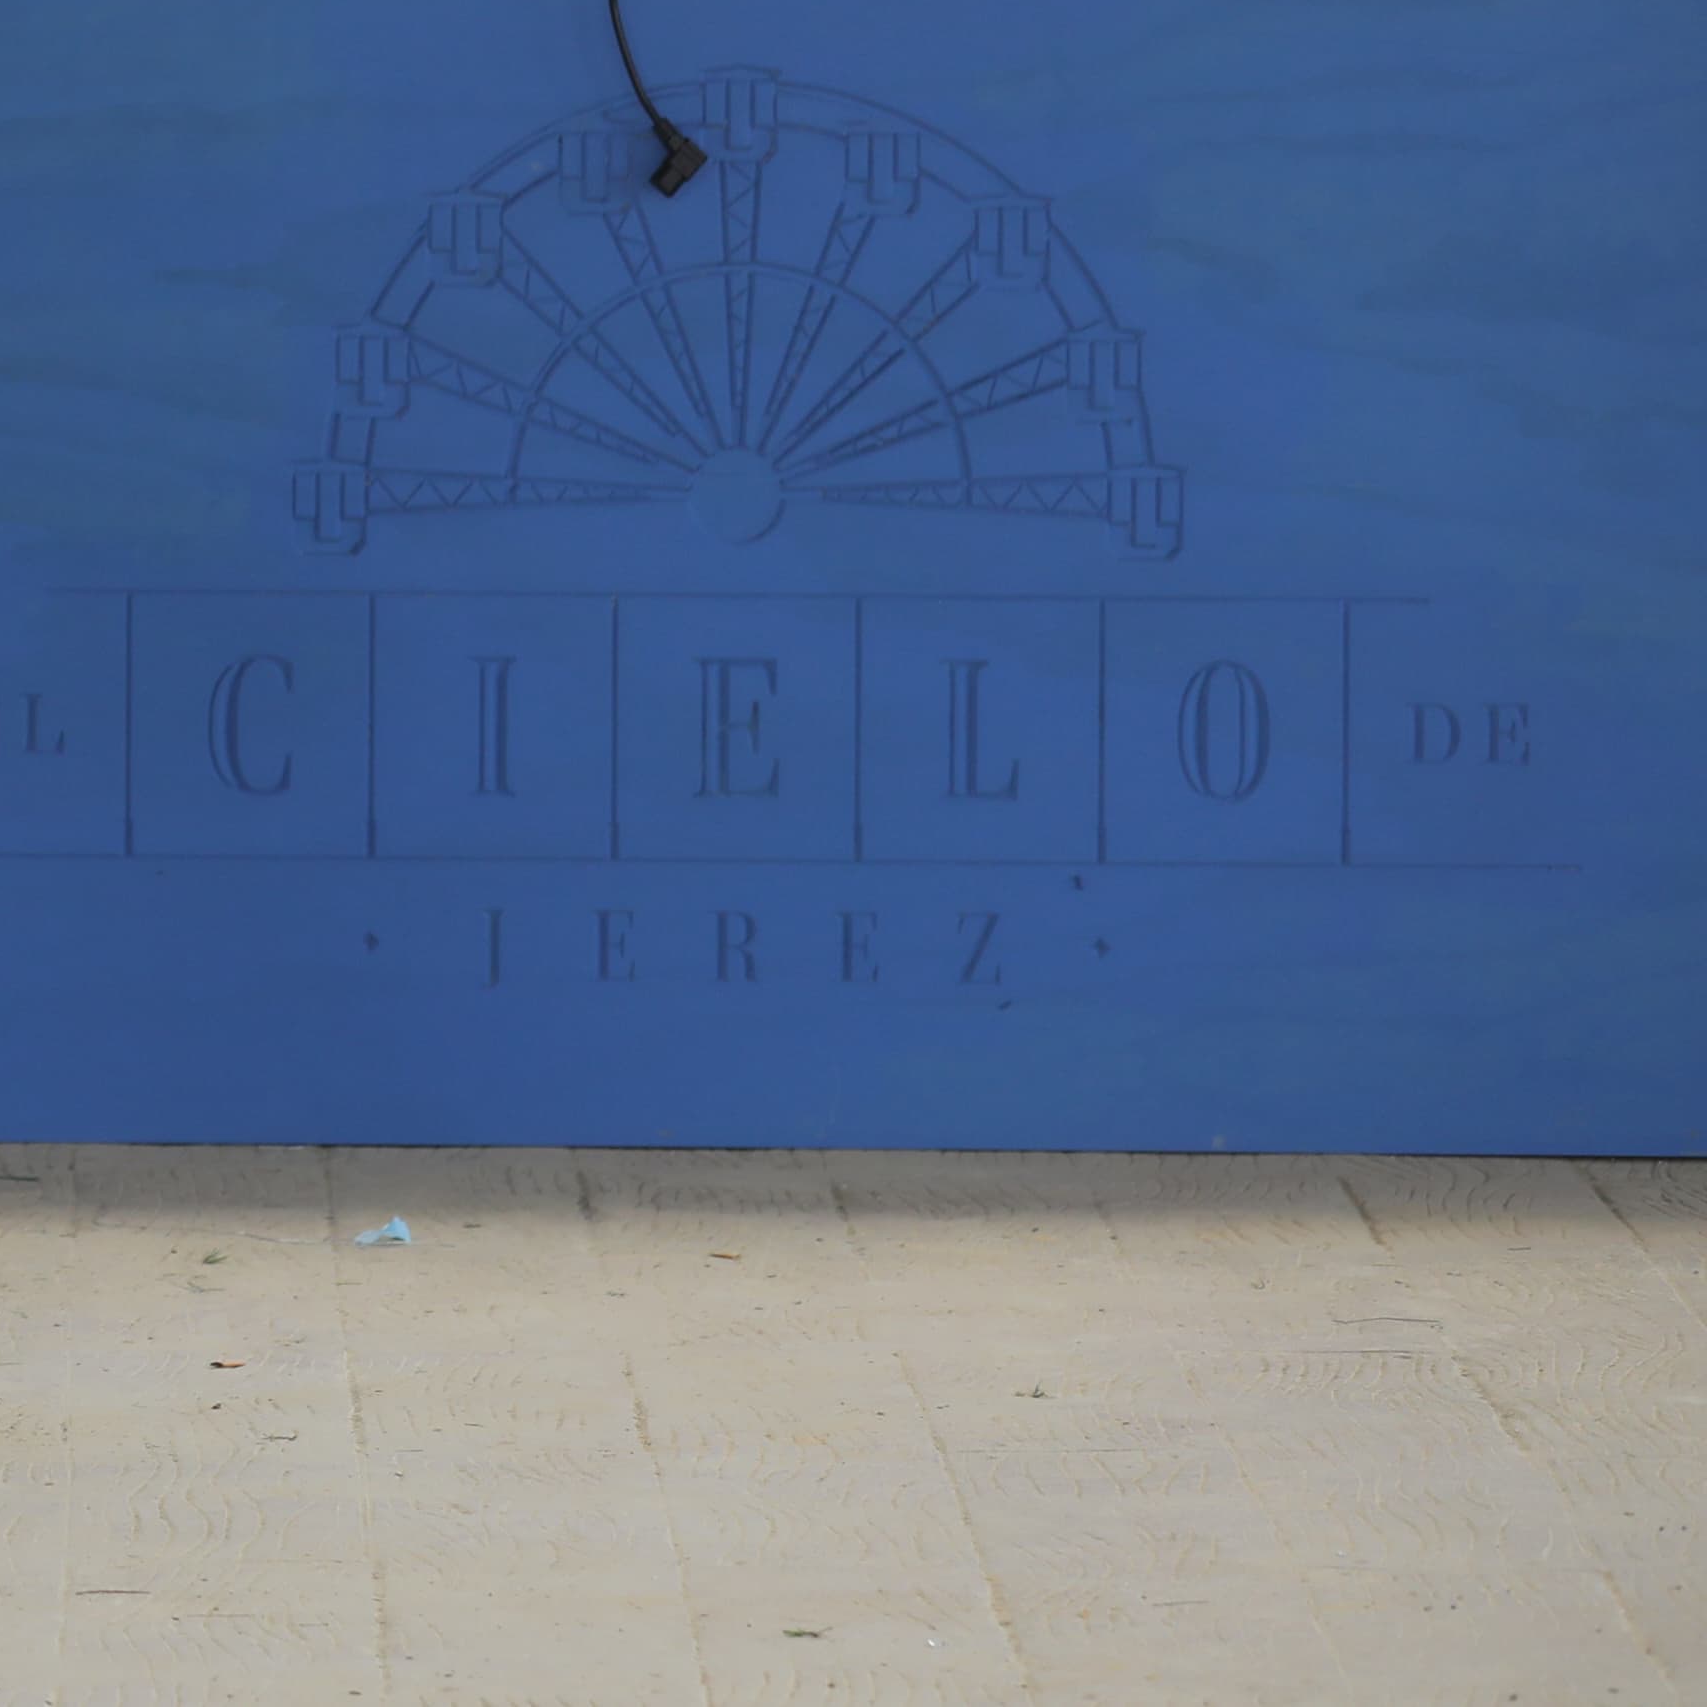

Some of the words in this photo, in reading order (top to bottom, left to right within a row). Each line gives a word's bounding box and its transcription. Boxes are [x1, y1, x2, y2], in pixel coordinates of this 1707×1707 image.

[207, 653, 1272, 803] CIELO
[1407, 702, 1533, 767] DE
[481, 908, 1003, 988] JEREZ
